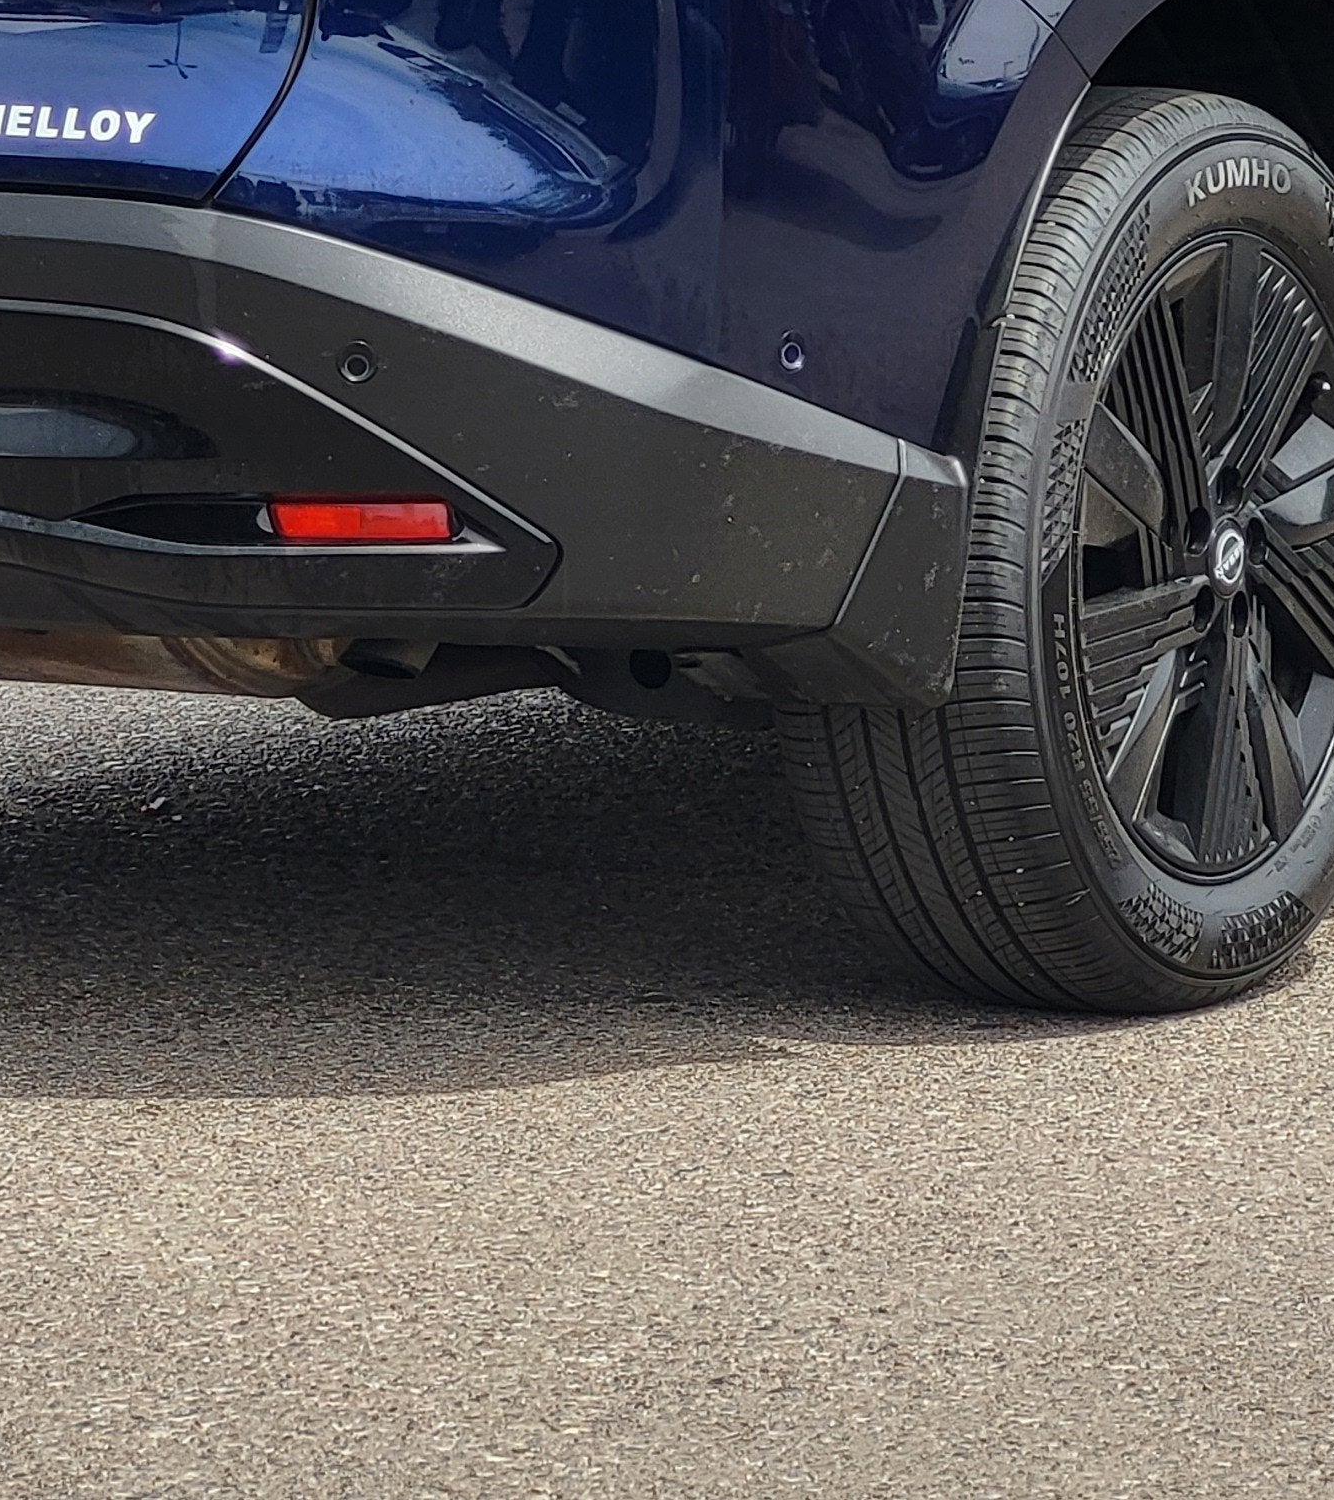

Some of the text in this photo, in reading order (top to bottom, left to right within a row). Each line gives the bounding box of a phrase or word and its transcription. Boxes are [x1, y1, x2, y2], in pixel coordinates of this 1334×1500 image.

[1185, 157, 1291, 207] KUMHO
[1053, 613, 1070, 699] 107H
[1064, 712, 1085, 772] R20
